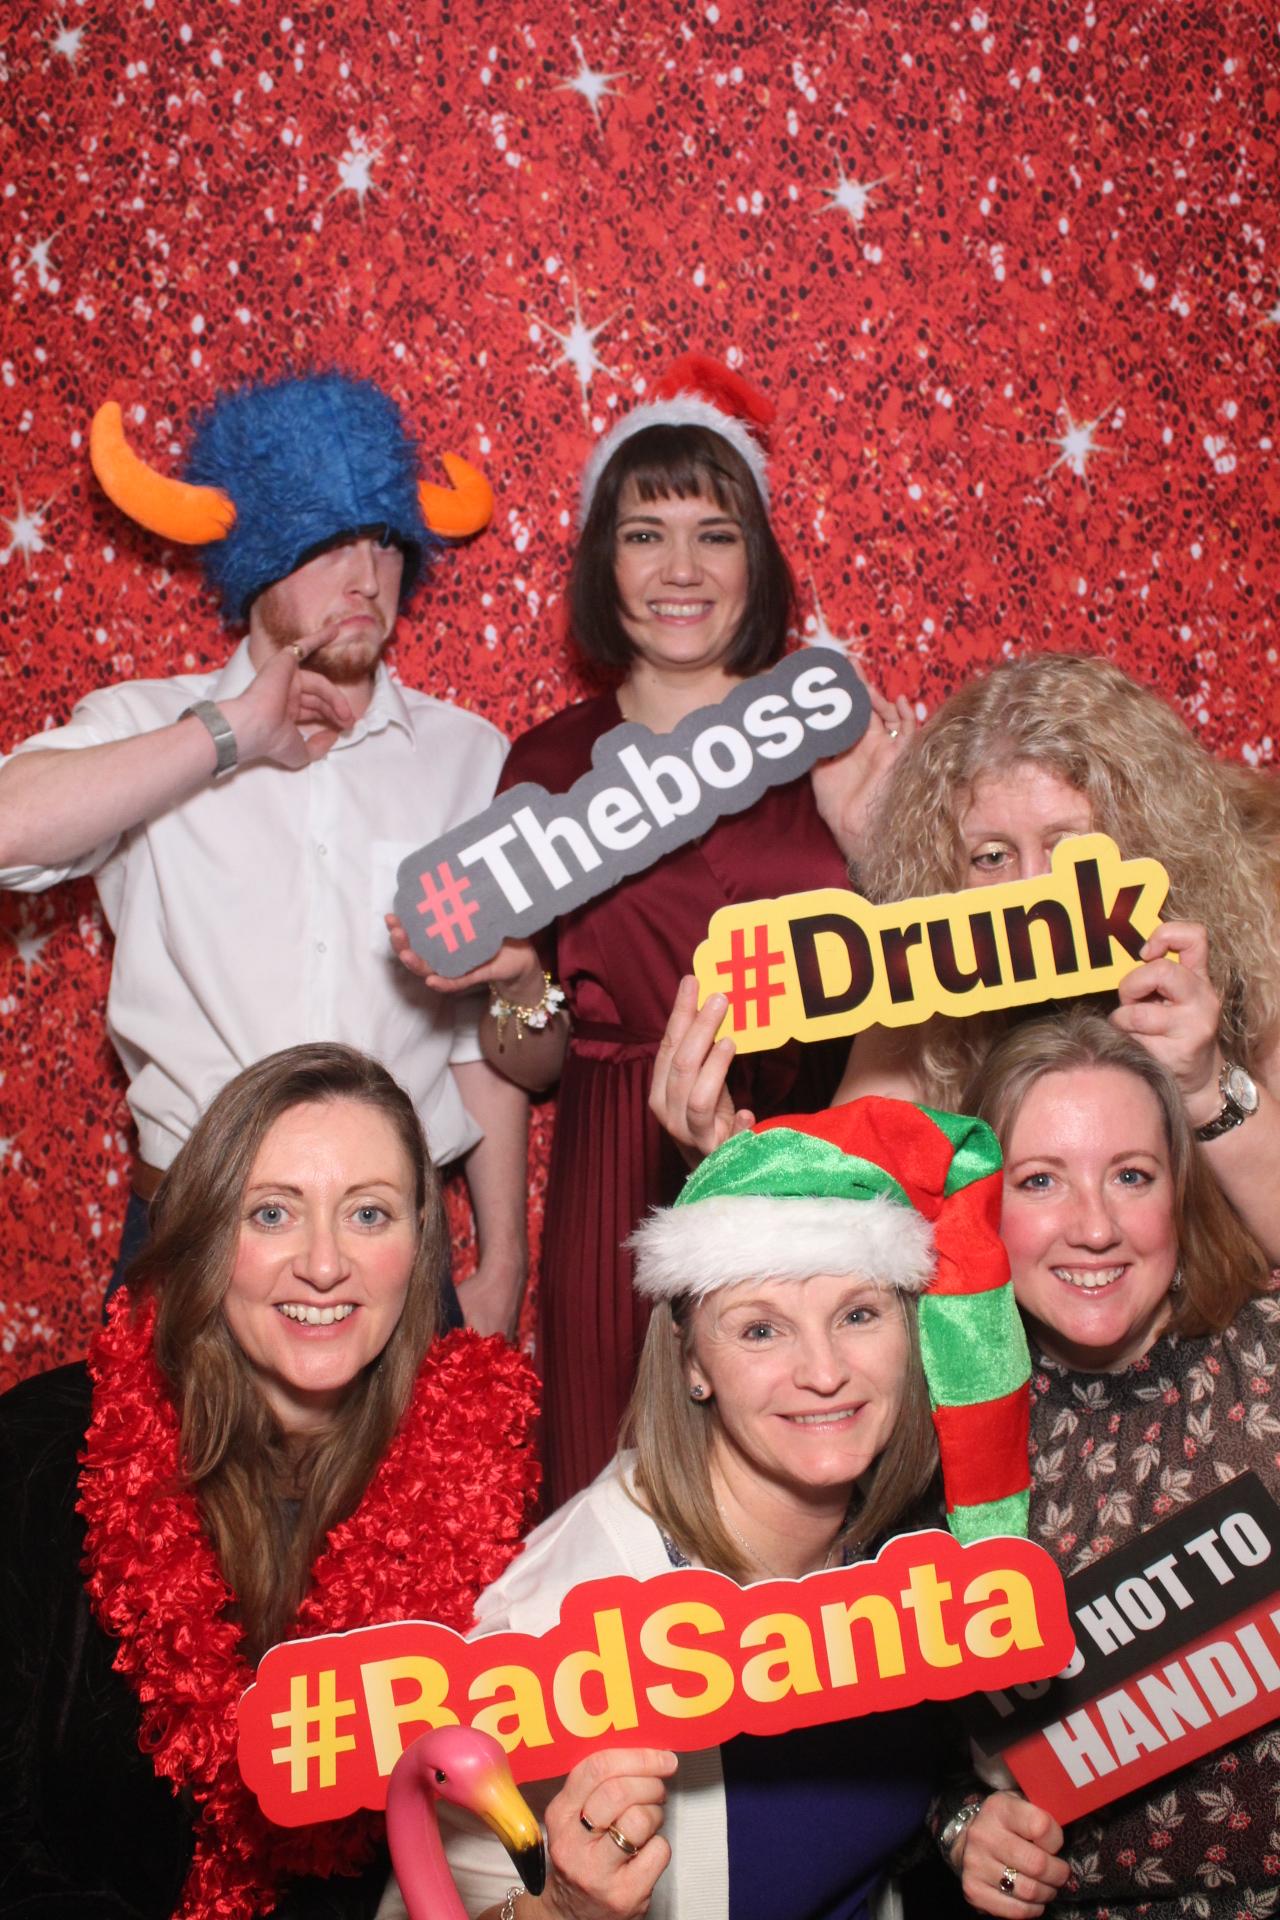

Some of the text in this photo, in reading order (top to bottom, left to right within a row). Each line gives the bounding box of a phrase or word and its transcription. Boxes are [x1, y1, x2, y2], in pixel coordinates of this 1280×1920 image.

[416, 665, 853, 955] #Theboss
[715, 858, 1146, 1031] #Drunk
[1074, 1511, 1272, 1657] HOT TO
[271, 1563, 1044, 1794] #BadSanta
[1042, 1609, 1280, 1789] HANDL
